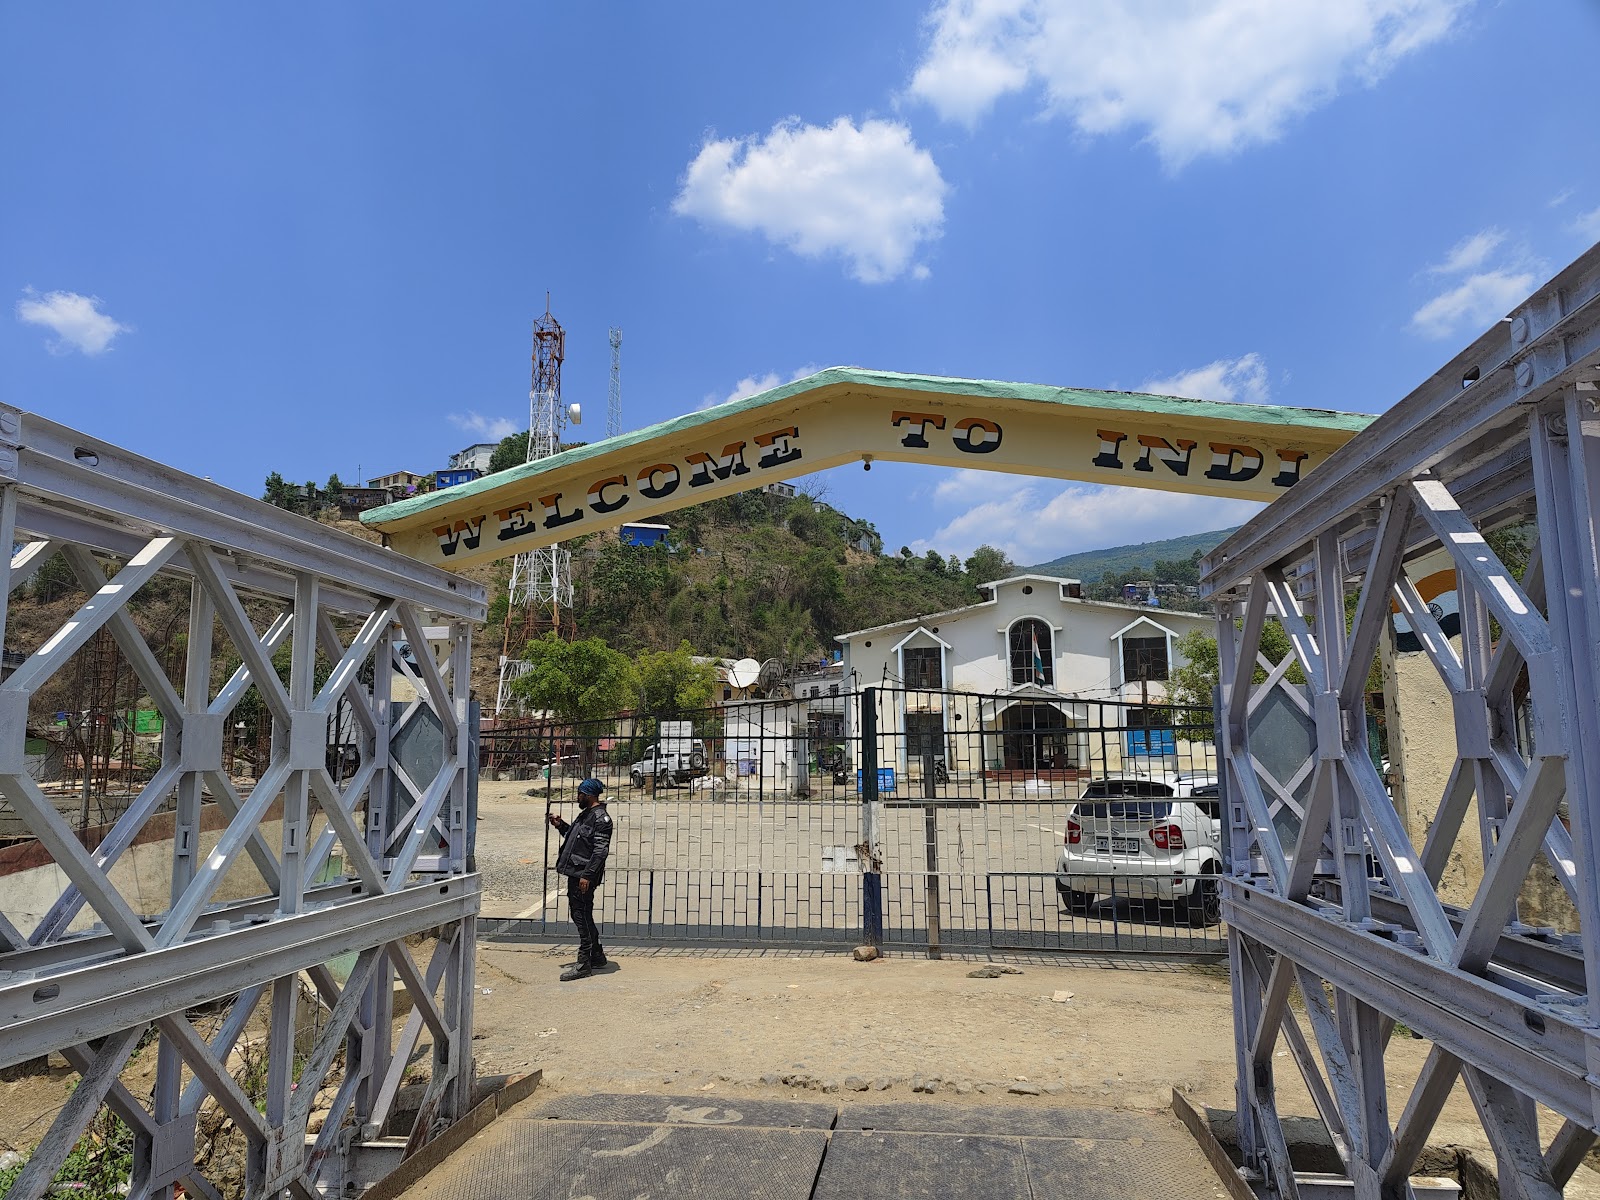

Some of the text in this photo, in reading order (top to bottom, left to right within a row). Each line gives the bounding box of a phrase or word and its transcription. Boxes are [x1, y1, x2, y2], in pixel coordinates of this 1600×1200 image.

[432, 410, 1309, 556] WELCOME TO INDI
